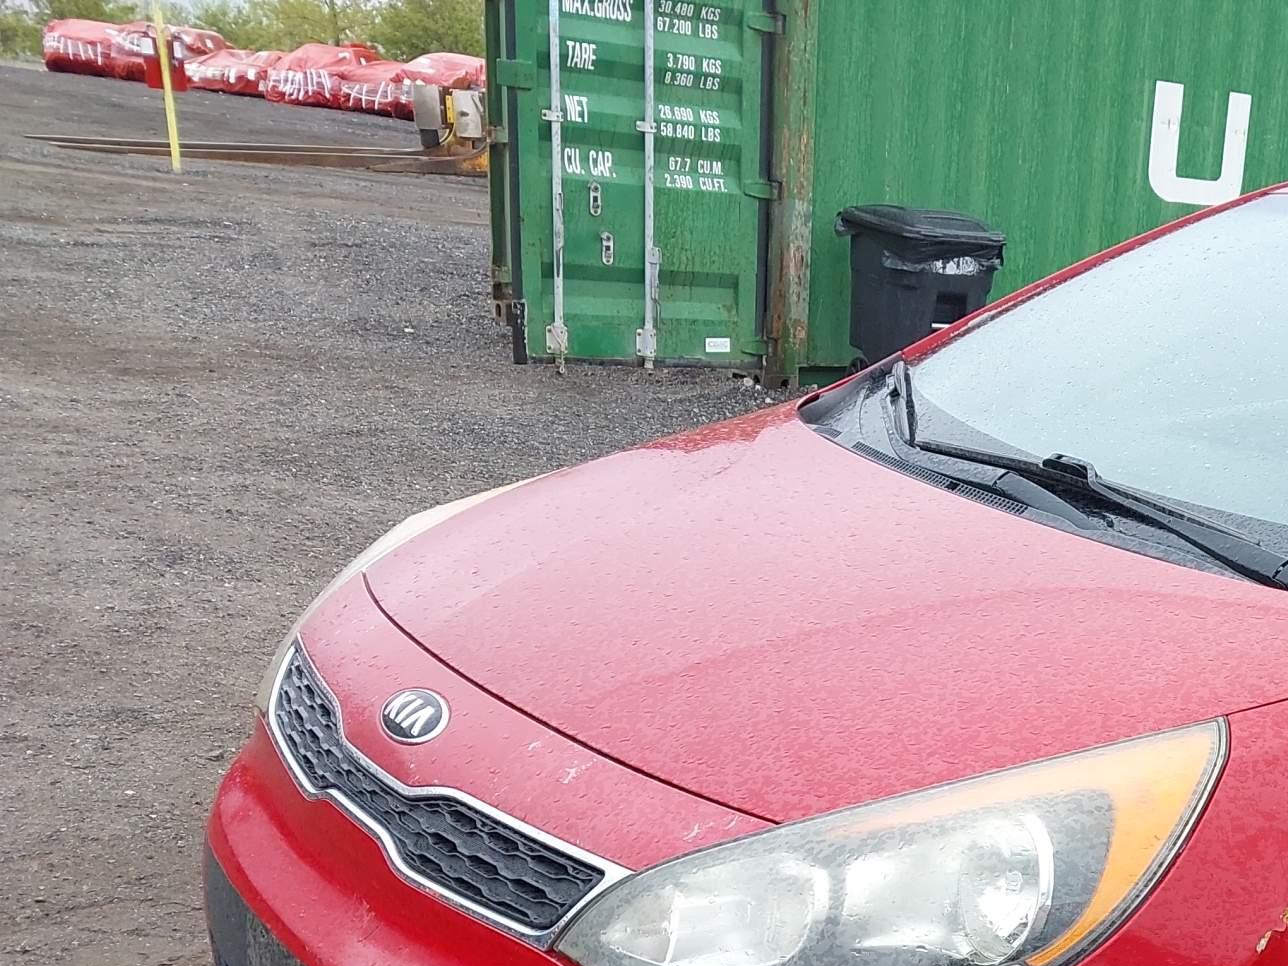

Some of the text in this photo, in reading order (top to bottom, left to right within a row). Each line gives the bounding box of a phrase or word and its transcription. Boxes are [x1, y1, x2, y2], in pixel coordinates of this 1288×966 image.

[658, 0, 721, 21] 30.480 KGS
[657, 17, 719, 39] 67.200 LBS
[567, 41, 597, 70] TARE
[667, 53, 722, 75] 3.790 KGS
[664, 71, 721, 91] 8.360 LBS
[564, 94, 589, 123] NET
[658, 104, 720, 125] 26.690 KGS
[660, 122, 721, 143] 58.840 LBS
[564, 147, 617, 178] CU. CAP.
[668, 156, 724, 176] 67.7 CU.M.
[664, 173, 694, 190] 2.390
